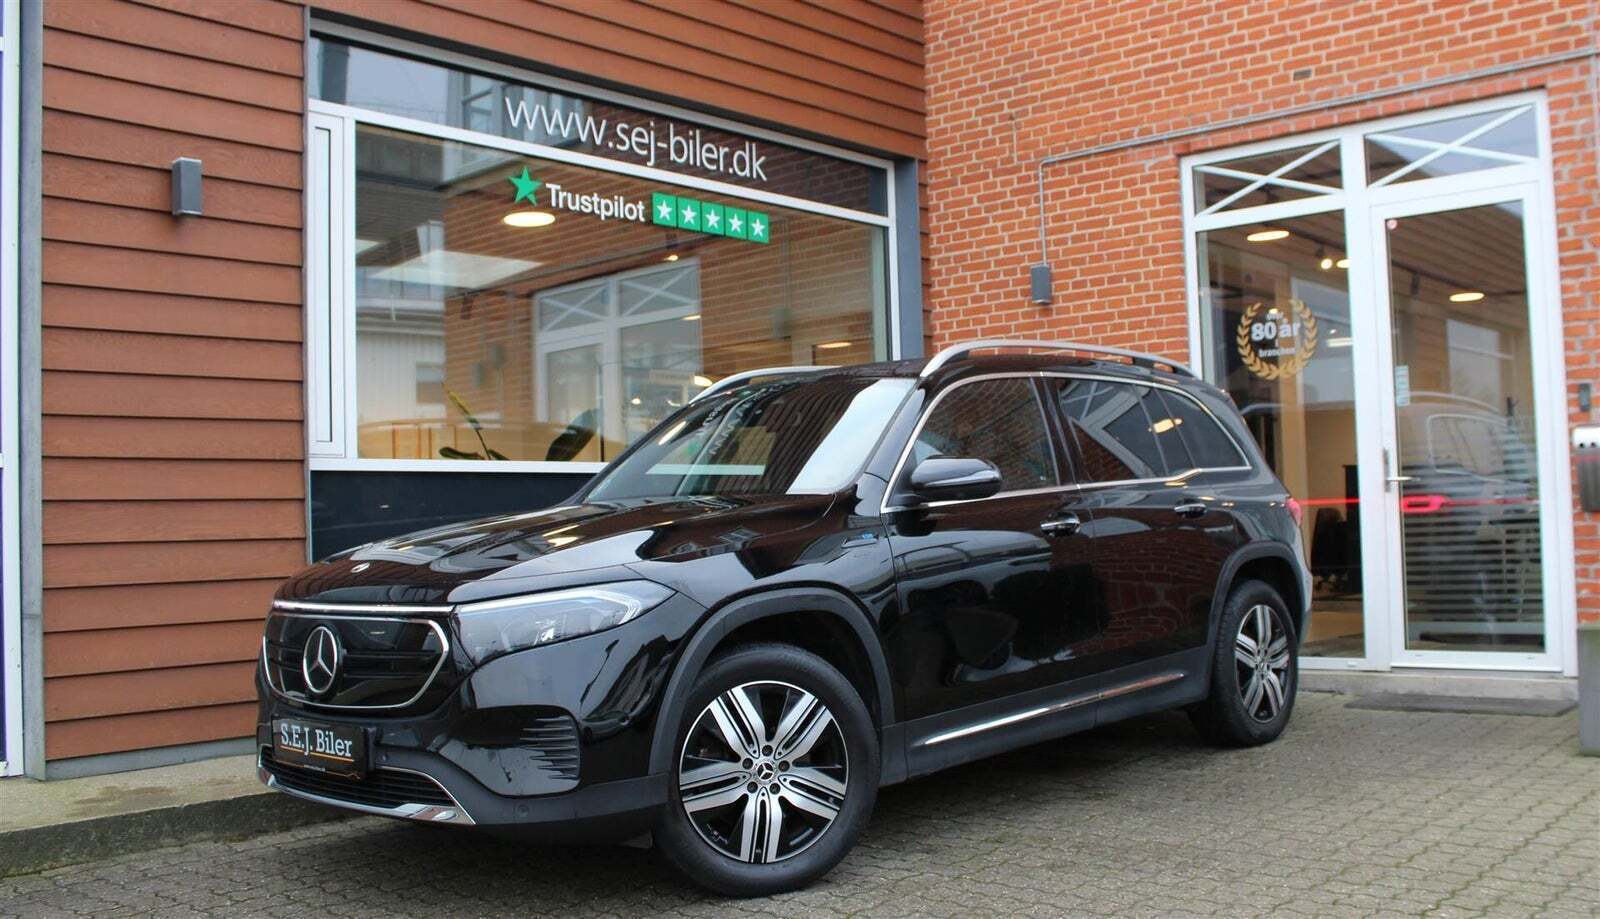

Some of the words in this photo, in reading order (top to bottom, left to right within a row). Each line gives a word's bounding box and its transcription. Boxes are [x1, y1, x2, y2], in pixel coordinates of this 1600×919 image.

[505, 97, 767, 181] www.sej-biler.dk
[546, 183, 646, 222] Trustpilot
[1251, 321, 1277, 342] 80
[1279, 318, 1301, 338] år
[280, 723, 313, 756] S.E.J.
[315, 729, 353, 757] Biler
